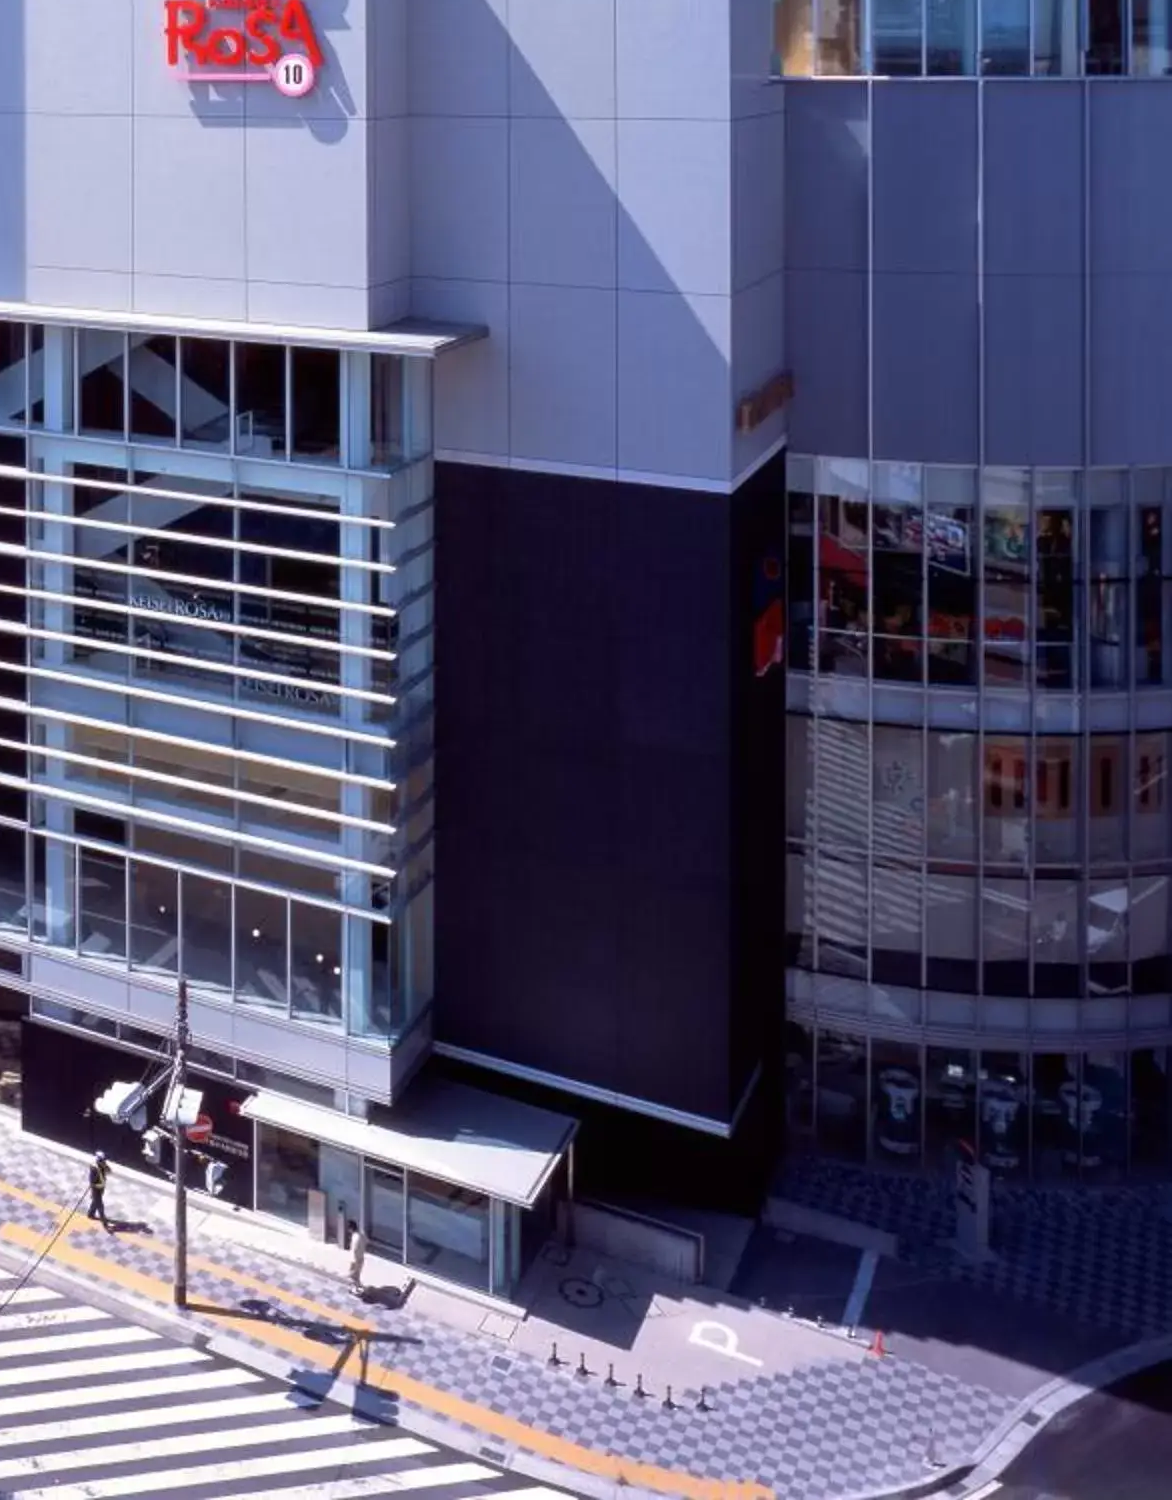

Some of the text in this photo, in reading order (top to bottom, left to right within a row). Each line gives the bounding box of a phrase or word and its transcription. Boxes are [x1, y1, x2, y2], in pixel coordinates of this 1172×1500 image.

[283, 63, 304, 85] 10
[174, 598, 219, 621] ROSA
[688, 1319, 765, 1368] P
